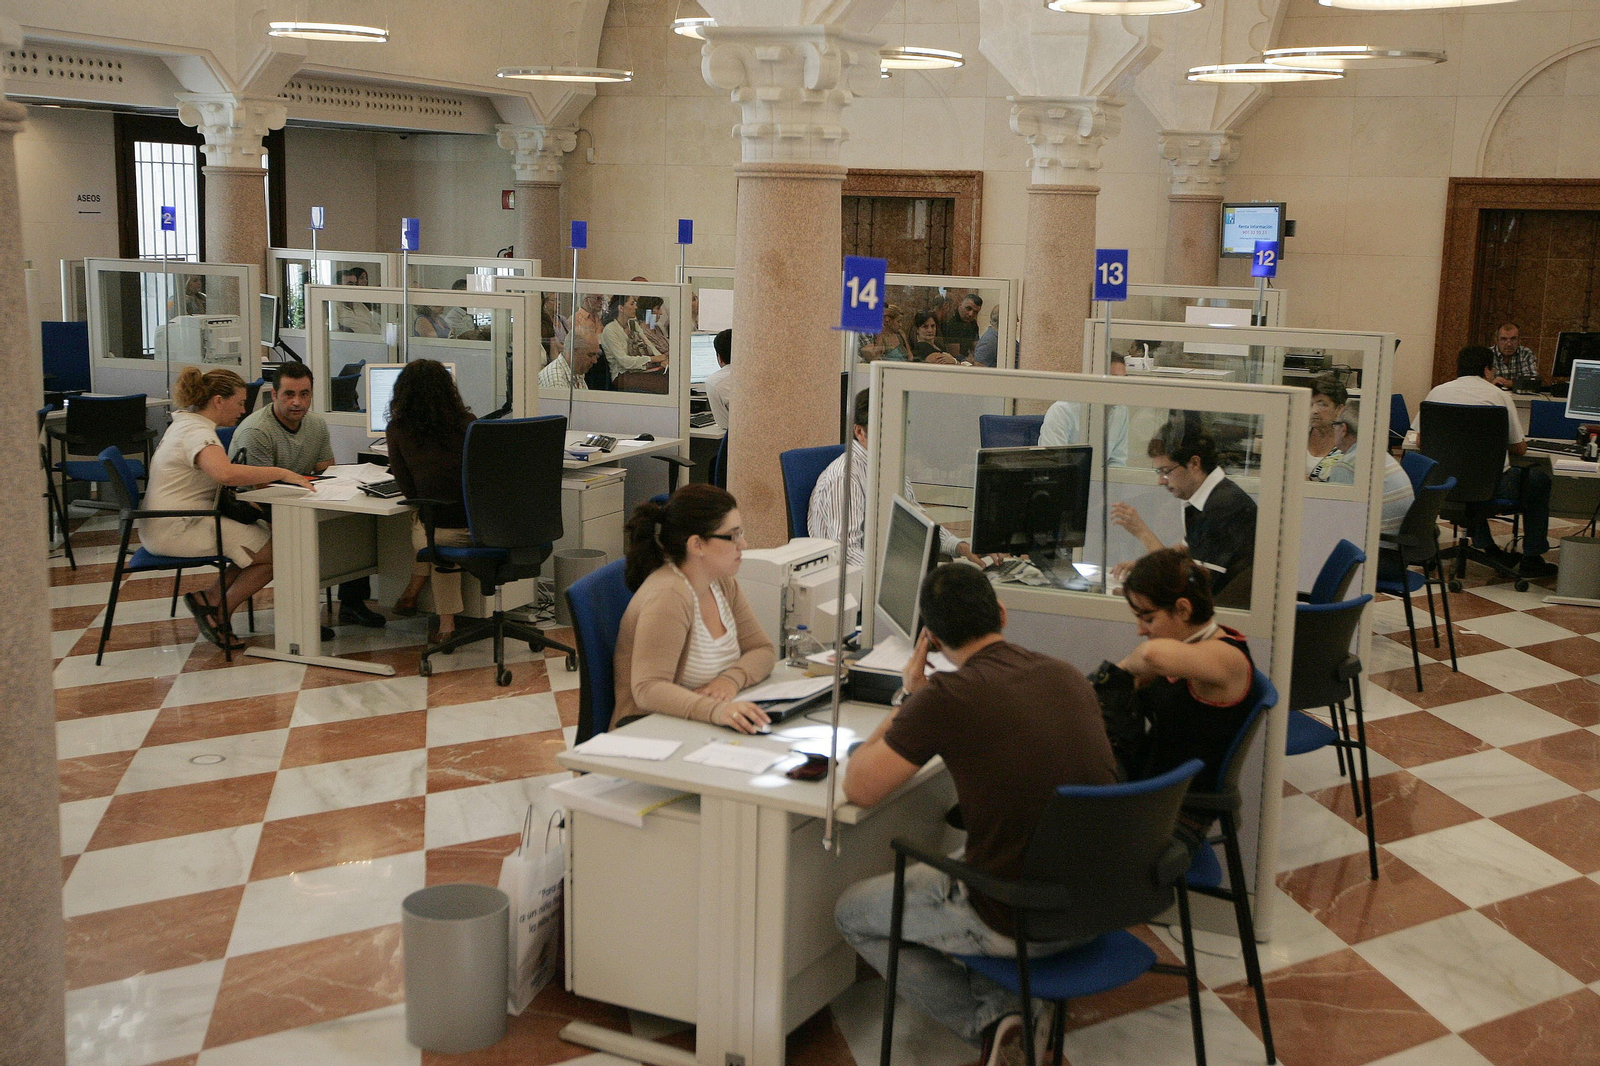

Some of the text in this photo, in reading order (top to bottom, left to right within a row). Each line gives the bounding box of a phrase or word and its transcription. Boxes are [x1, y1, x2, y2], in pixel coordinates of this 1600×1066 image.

[77, 194, 101, 202] ASEOS
[163, 212, 172, 224] 2
[1256, 250, 1275, 266] 12
[1098, 262, 1124, 286] 13
[846, 276, 879, 310] 14
